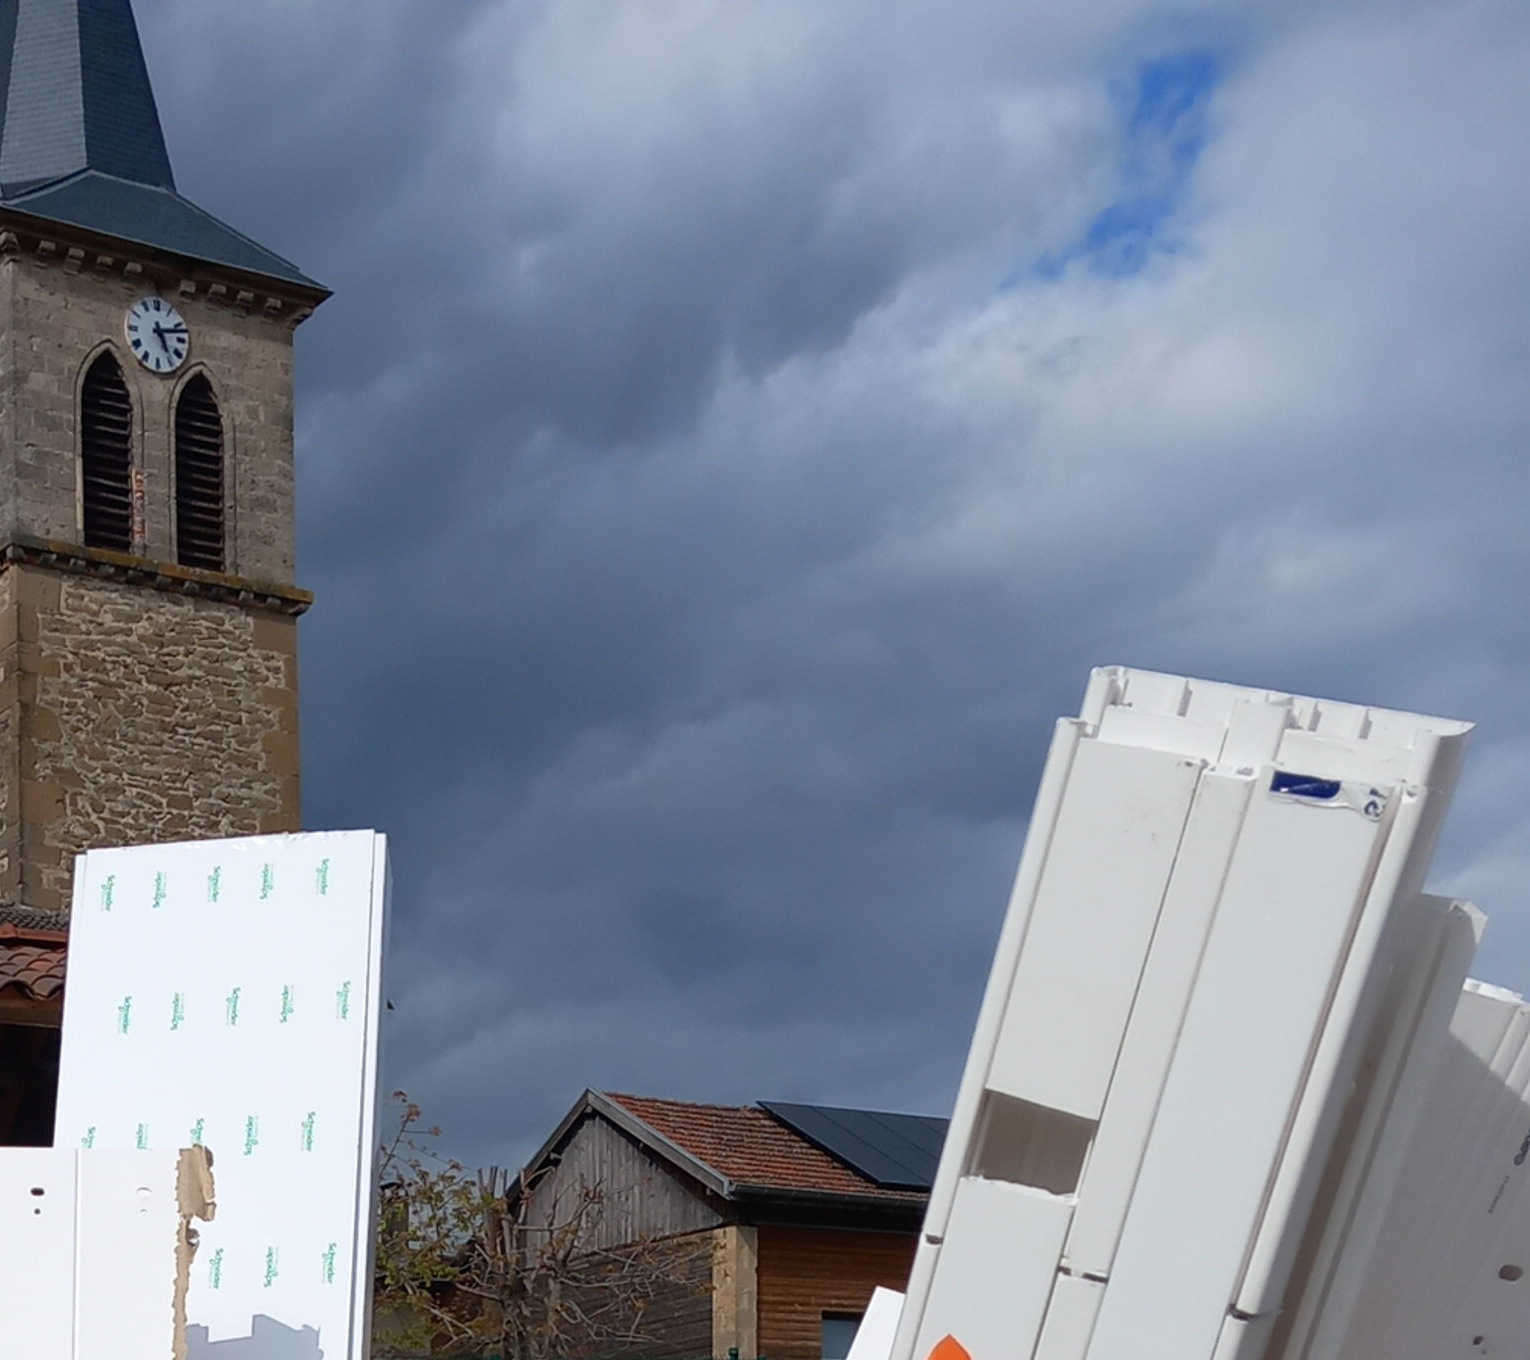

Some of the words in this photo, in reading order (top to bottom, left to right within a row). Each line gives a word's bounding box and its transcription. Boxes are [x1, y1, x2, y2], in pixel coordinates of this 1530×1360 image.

[101, 875, 115, 911] Schneider
[153, 871, 165, 909] Schneider
[208, 866, 221, 903] Schneider
[261, 864, 274, 900] Schneider
[316, 857, 330, 896] Schneider
[118, 996, 132, 1035] Schneider
[171, 993, 184, 1031] Schneider
[226, 987, 241, 1025] Schneider
[281, 985, 294, 1023] Schneider
[336, 981, 351, 1020] Schneider
[244, 1116, 259, 1156] Schneider
[302, 1111, 316, 1152] Schneider
[209, 1248, 224, 1289] Schneider
[264, 1246, 279, 1288] Schneider
[322, 1242, 337, 1285] Schneider
